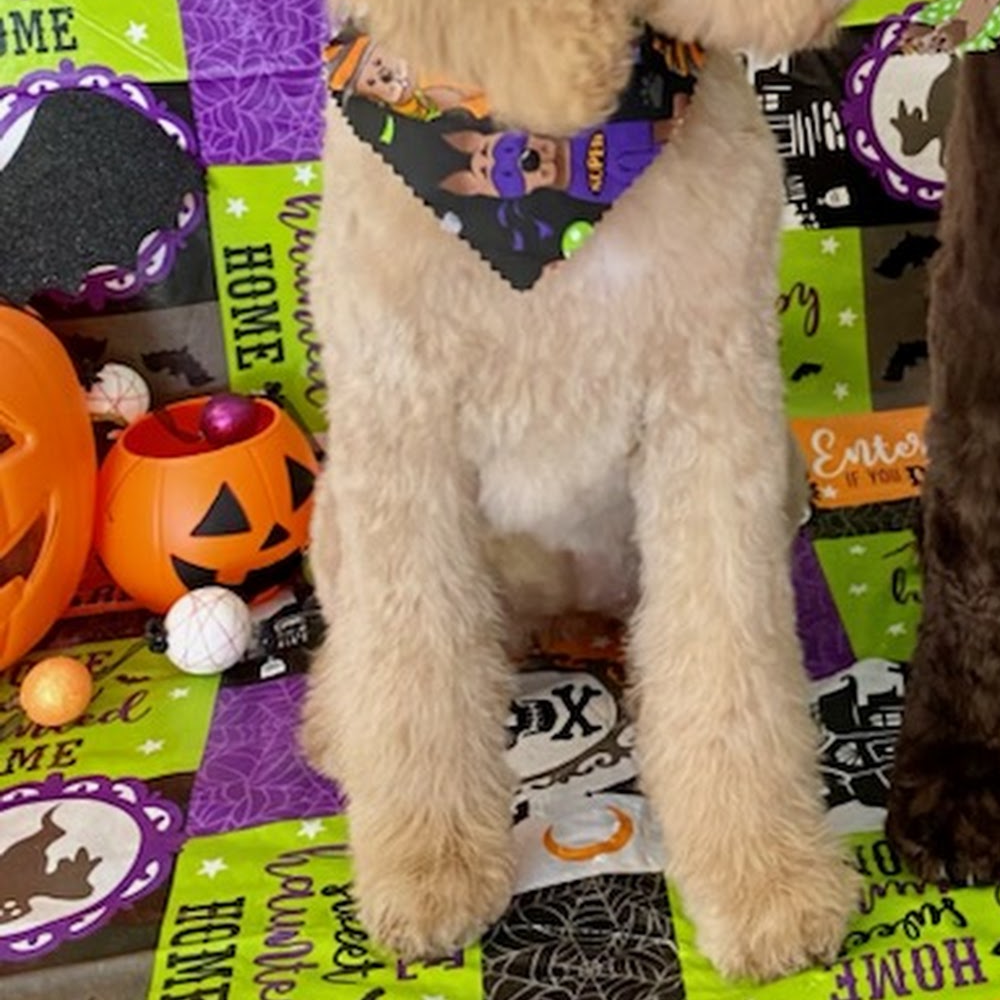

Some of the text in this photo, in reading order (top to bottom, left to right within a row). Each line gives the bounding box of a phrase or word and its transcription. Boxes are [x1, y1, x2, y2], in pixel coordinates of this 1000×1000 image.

[223, 242, 285, 371] HOME
[845, 471, 859, 488] IF
[869, 468, 903, 486] YOU
[837, 897, 968, 958] swee
[830, 937, 988, 1000] HOME
